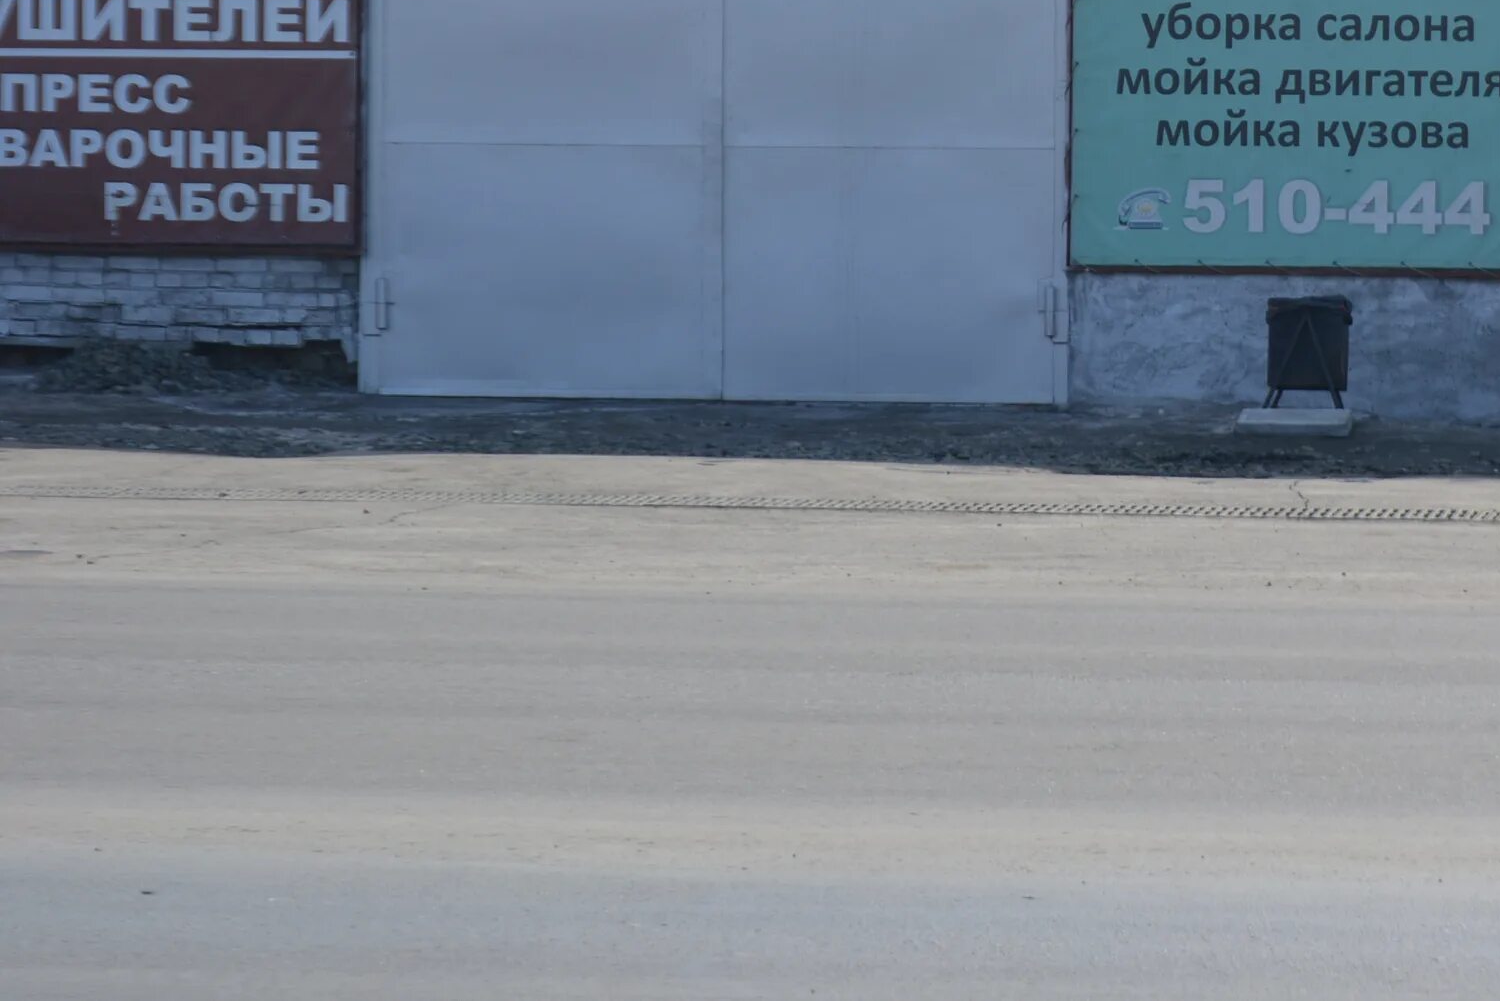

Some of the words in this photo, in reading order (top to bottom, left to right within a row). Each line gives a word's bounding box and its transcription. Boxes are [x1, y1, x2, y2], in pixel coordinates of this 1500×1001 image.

[1141, 3, 1301, 48] уборка
[1316, 13, 1475, 42] салона
[1116, 57, 1261, 96] мойка
[1156, 109, 1300, 147] мойка
[1317, 121, 1470, 156] кузова
[104, 182, 348, 222] РАБОТЫ
[1183, 178, 1491, 236] 510-444
